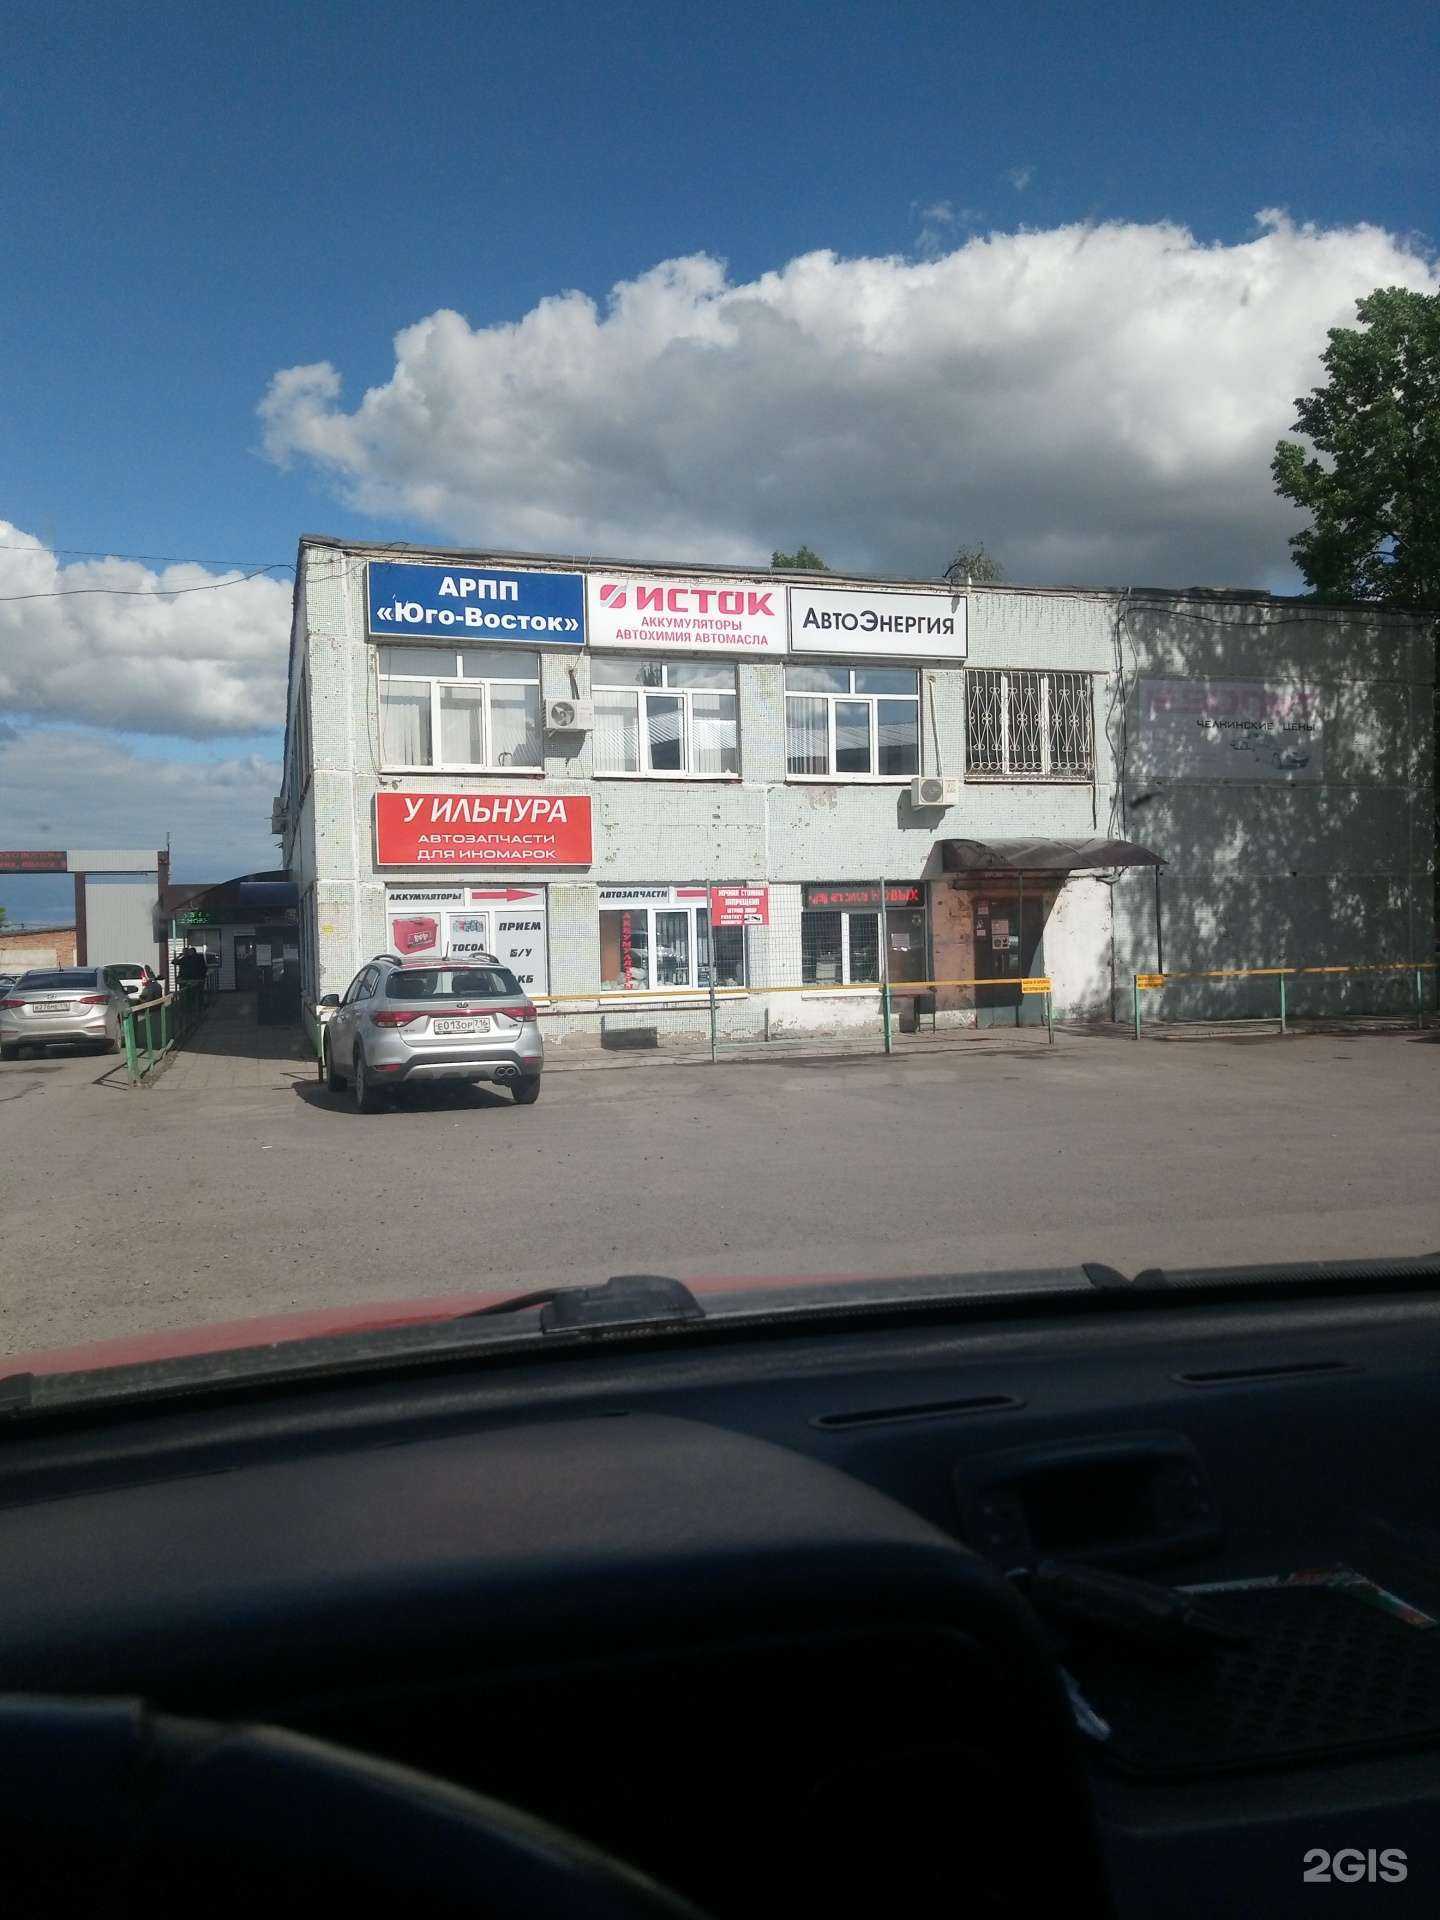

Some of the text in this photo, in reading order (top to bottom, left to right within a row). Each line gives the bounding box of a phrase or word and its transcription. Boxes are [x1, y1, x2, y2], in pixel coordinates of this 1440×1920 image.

[438, 576, 519, 601] АРПП
[636, 586, 776, 616] ИСТОК
[376, 602, 579, 632] «Юго-Восток»
[641, 615, 743, 632] АККУМУЛЯТОРЫ
[615, 629, 769, 647] АВТОХИМИЯ АВТОМАСЛА
[1282, 722, 1315, 731] ЦЕНЫ
[403, 797, 568, 823] У ИЛЬНУРА
[417, 834, 556, 845] АВТОЗАПЧАСТИ
[416, 849, 557, 861] ДЛЯ ИНОМАРОК
[389, 893, 462, 901] АККУМУЛЯТОРЫ
[599, 889, 668, 899] АВТОЗАПЧАСТИ
[498, 921, 542, 932] ПРИЕМ
[452, 943, 485, 952] ТОСОЛ
[509, 948, 533, 958] Б/У
[516, 974, 534, 983] КБ
